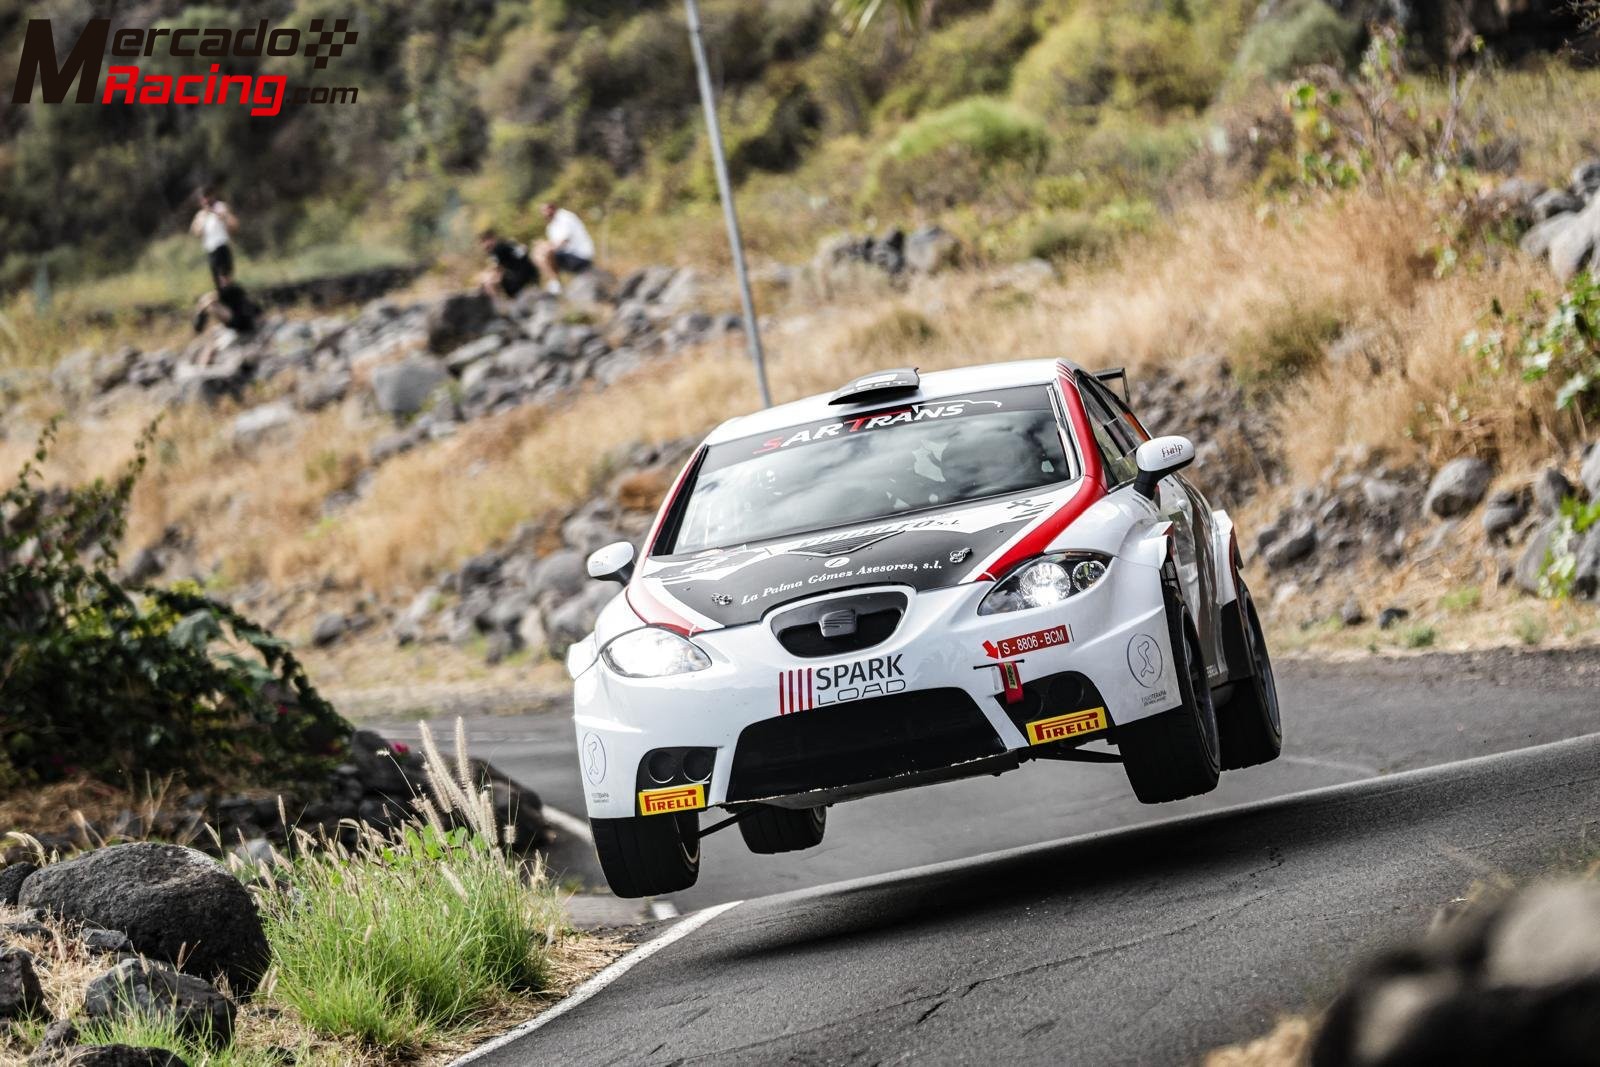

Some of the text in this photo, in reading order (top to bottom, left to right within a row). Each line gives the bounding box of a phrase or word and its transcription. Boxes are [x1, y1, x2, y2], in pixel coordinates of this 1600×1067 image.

[753, 403, 965, 455] SARTRANS
[741, 594, 759, 605] La
[762, 580, 803, 598] Palma
[857, 563, 918, 576] Asesores,
[922, 560, 942, 570] s.l.
[1016, 635, 1039, 651] 8806
[1044, 629, 1065, 645] BCM
[816, 653, 905, 690] SPARK
[818, 679, 906, 705] LOAD
[1034, 711, 1100, 741] PIRELLI
[644, 788, 697, 812] PIRELLI
